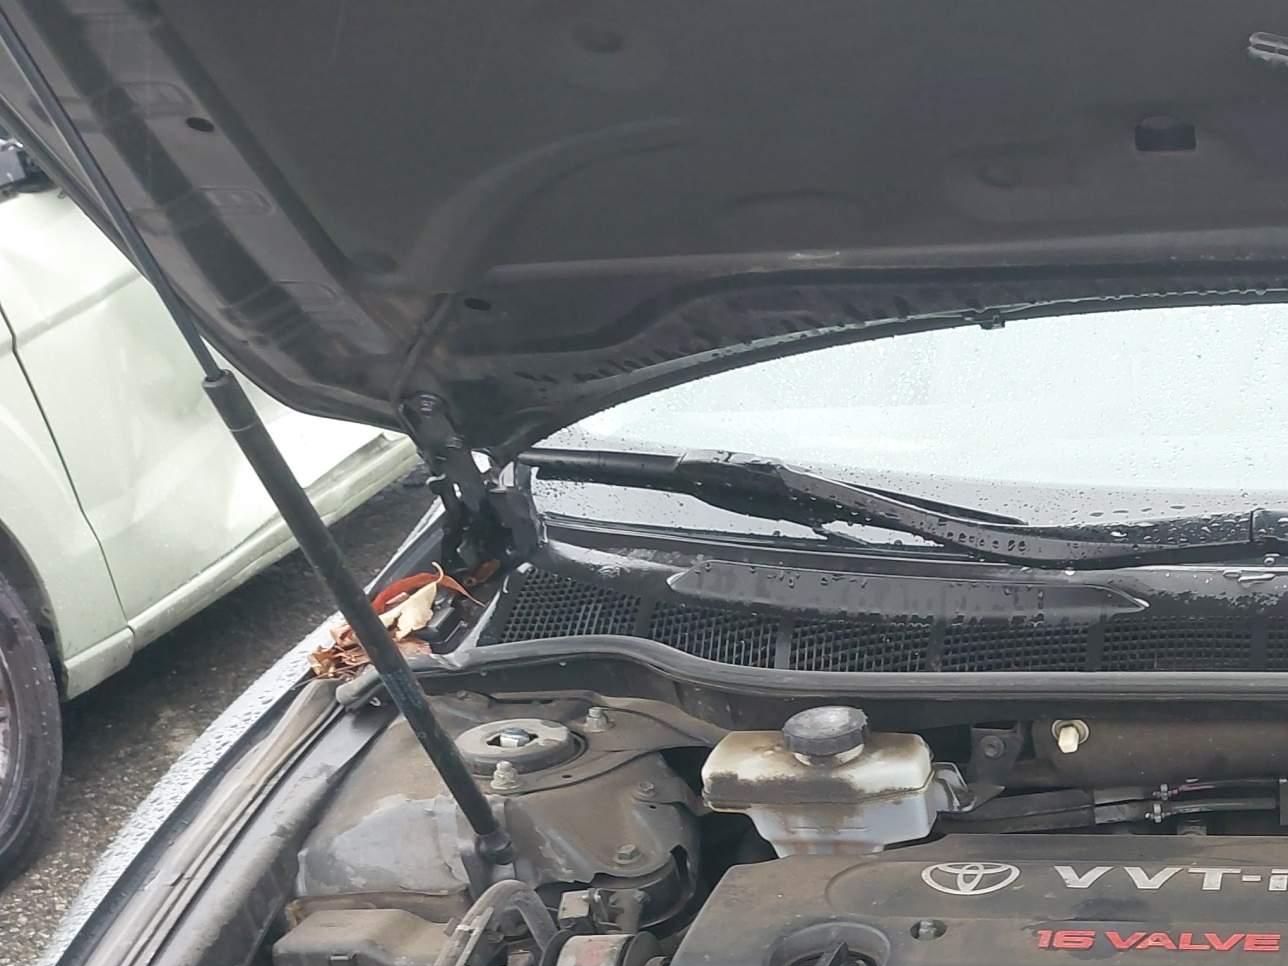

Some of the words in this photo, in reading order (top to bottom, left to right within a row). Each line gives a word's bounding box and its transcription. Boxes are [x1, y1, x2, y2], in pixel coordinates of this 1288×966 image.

[1055, 865, 1288, 892] VVT-i
[1037, 930, 1096, 950] 16
[1103, 931, 1281, 951] VALVE
